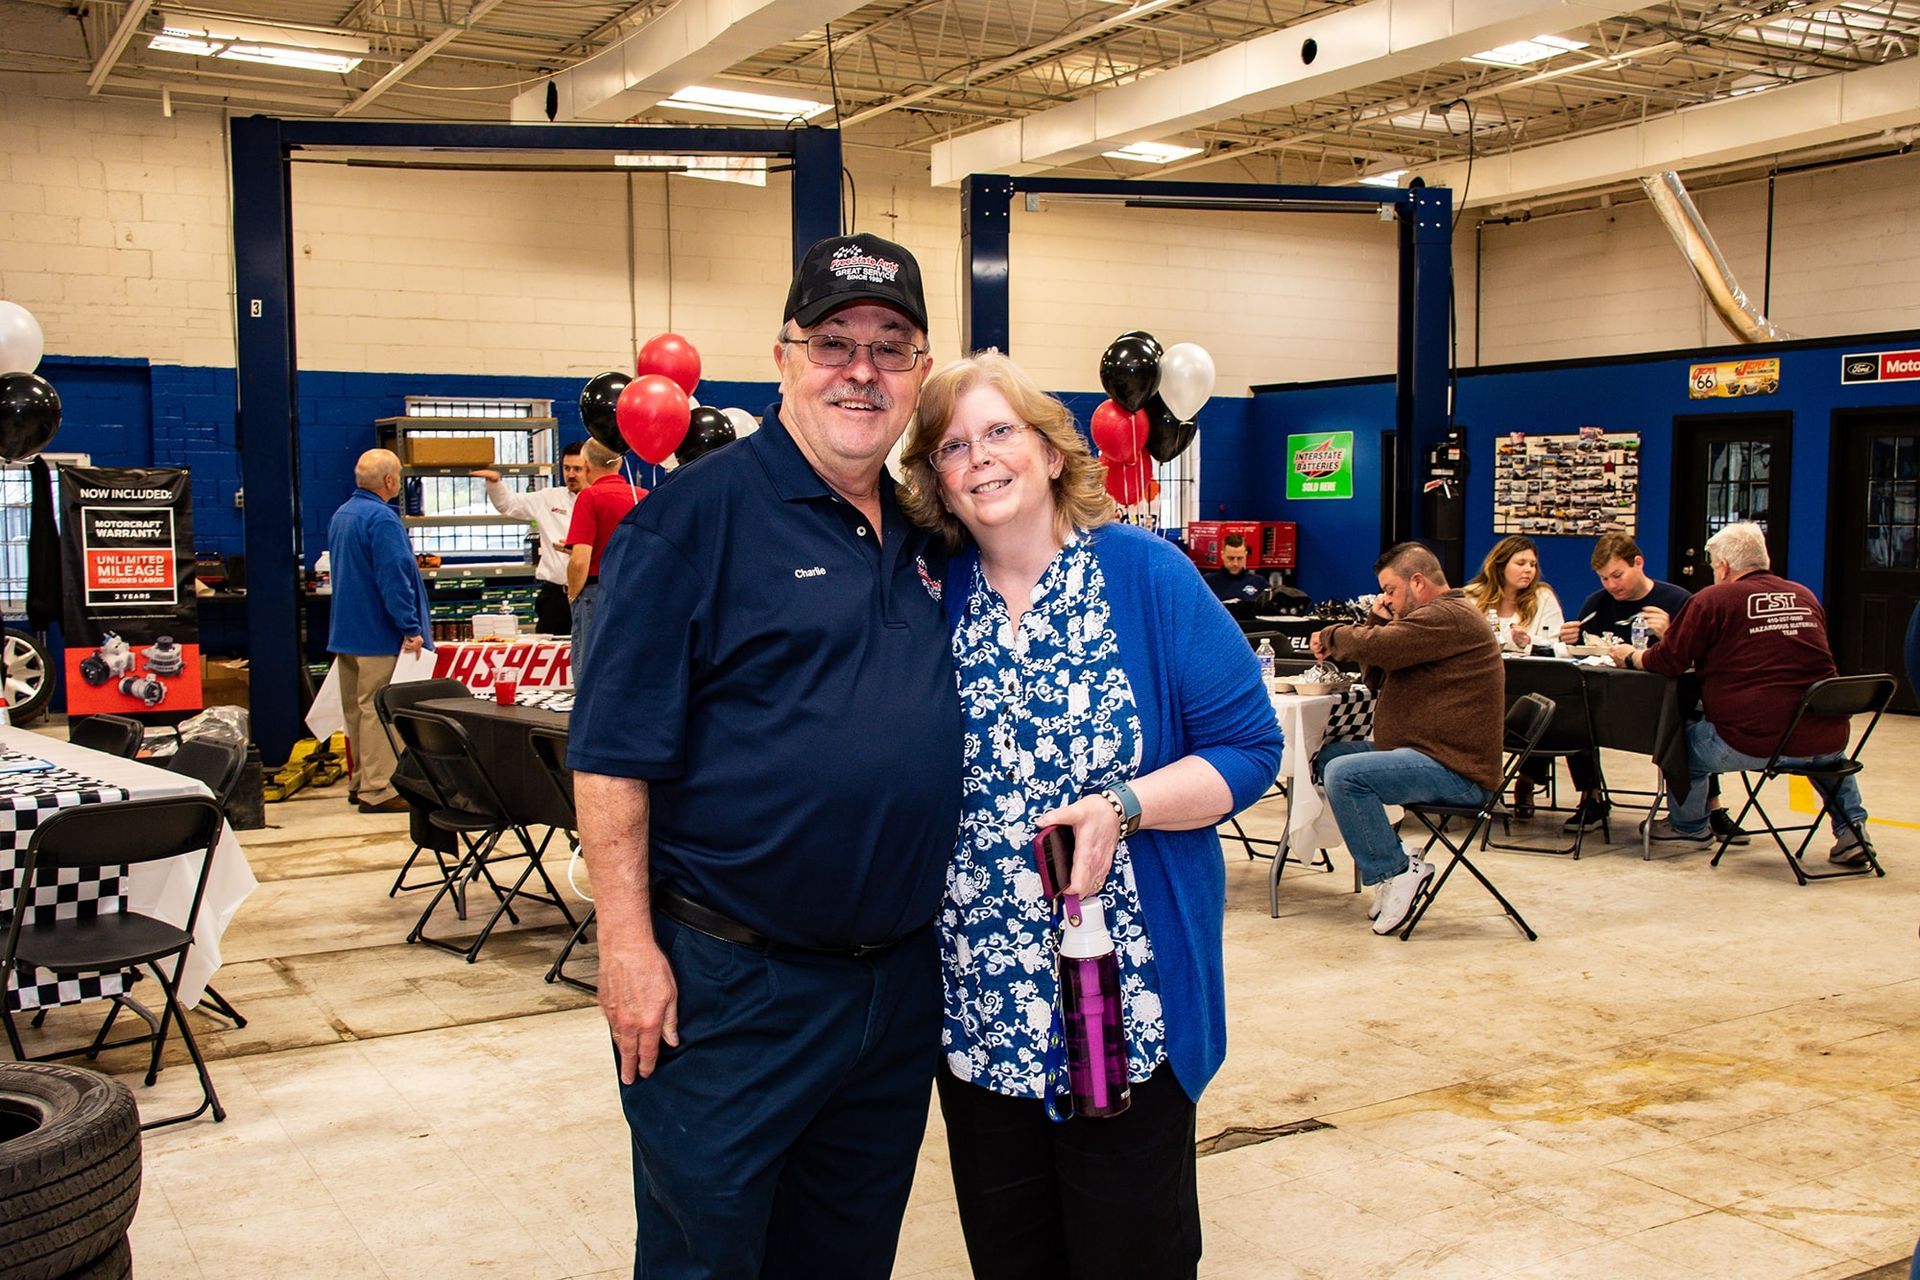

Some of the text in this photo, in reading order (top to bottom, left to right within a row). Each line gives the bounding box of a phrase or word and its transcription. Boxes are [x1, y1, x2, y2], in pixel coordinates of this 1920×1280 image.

[835, 268, 896, 282] GREAT SERVICE
[253, 302, 260, 315] 3
[1851, 360, 1920, 374] Ford Moto
[1697, 375, 1713, 389] 66
[1295, 451, 1342, 460] INTERSTATE
[1296, 461, 1339, 470] BATTERIES
[80, 488, 172, 499] NOW INCLUDED:
[96, 529, 161, 538] WARRANTY
[97, 555, 164, 564] UNLIMITED
[97, 565, 164, 576] MILEAGE
[795, 566, 826, 578] Charlie
[1747, 593, 1812, 619] CST
[1749, 623, 1789, 634] HAZARDOUS
[1287, 637, 1309, 649] EL
